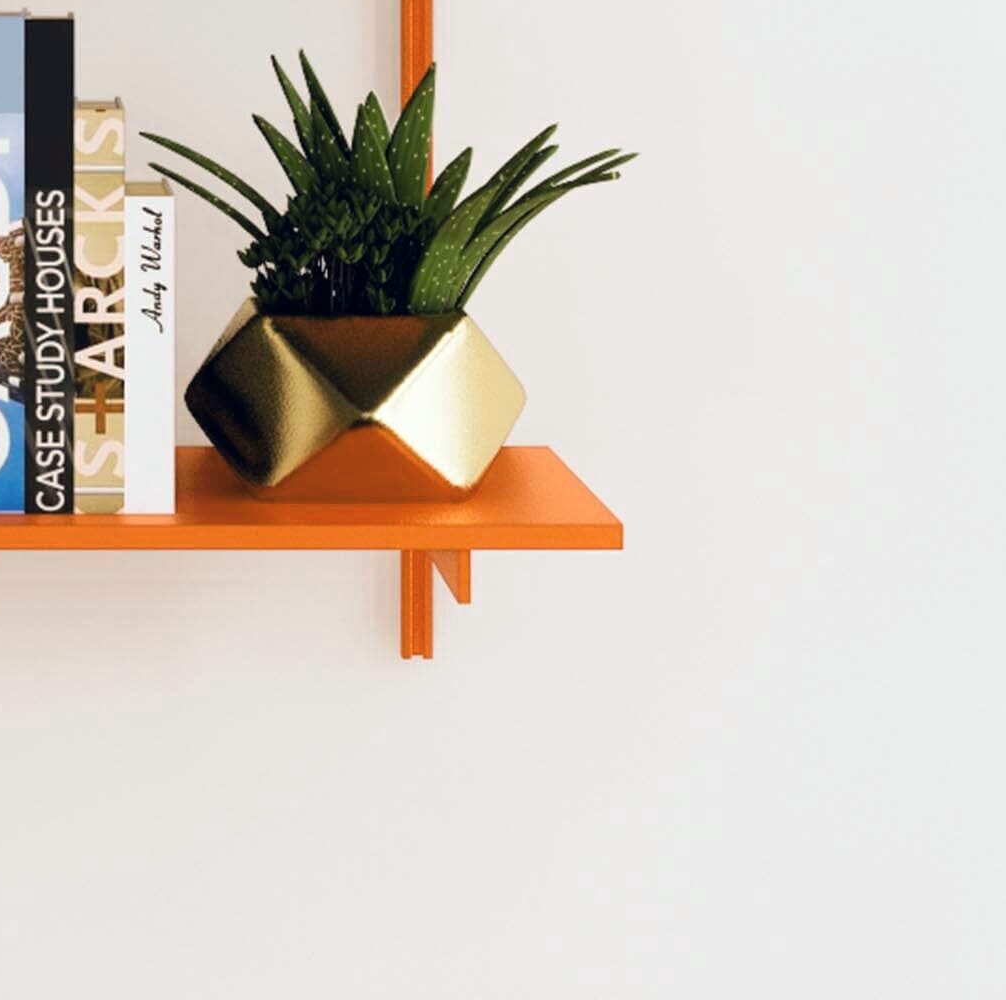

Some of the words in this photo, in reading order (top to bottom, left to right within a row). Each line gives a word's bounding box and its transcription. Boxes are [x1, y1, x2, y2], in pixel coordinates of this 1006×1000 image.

[36, 189, 65, 315] HOUSES
[142, 207, 164, 272] Warhol
[141, 281, 166, 334] Andy
[36, 318, 65, 423] STUDY
[36, 431, 65, 513] CASE
